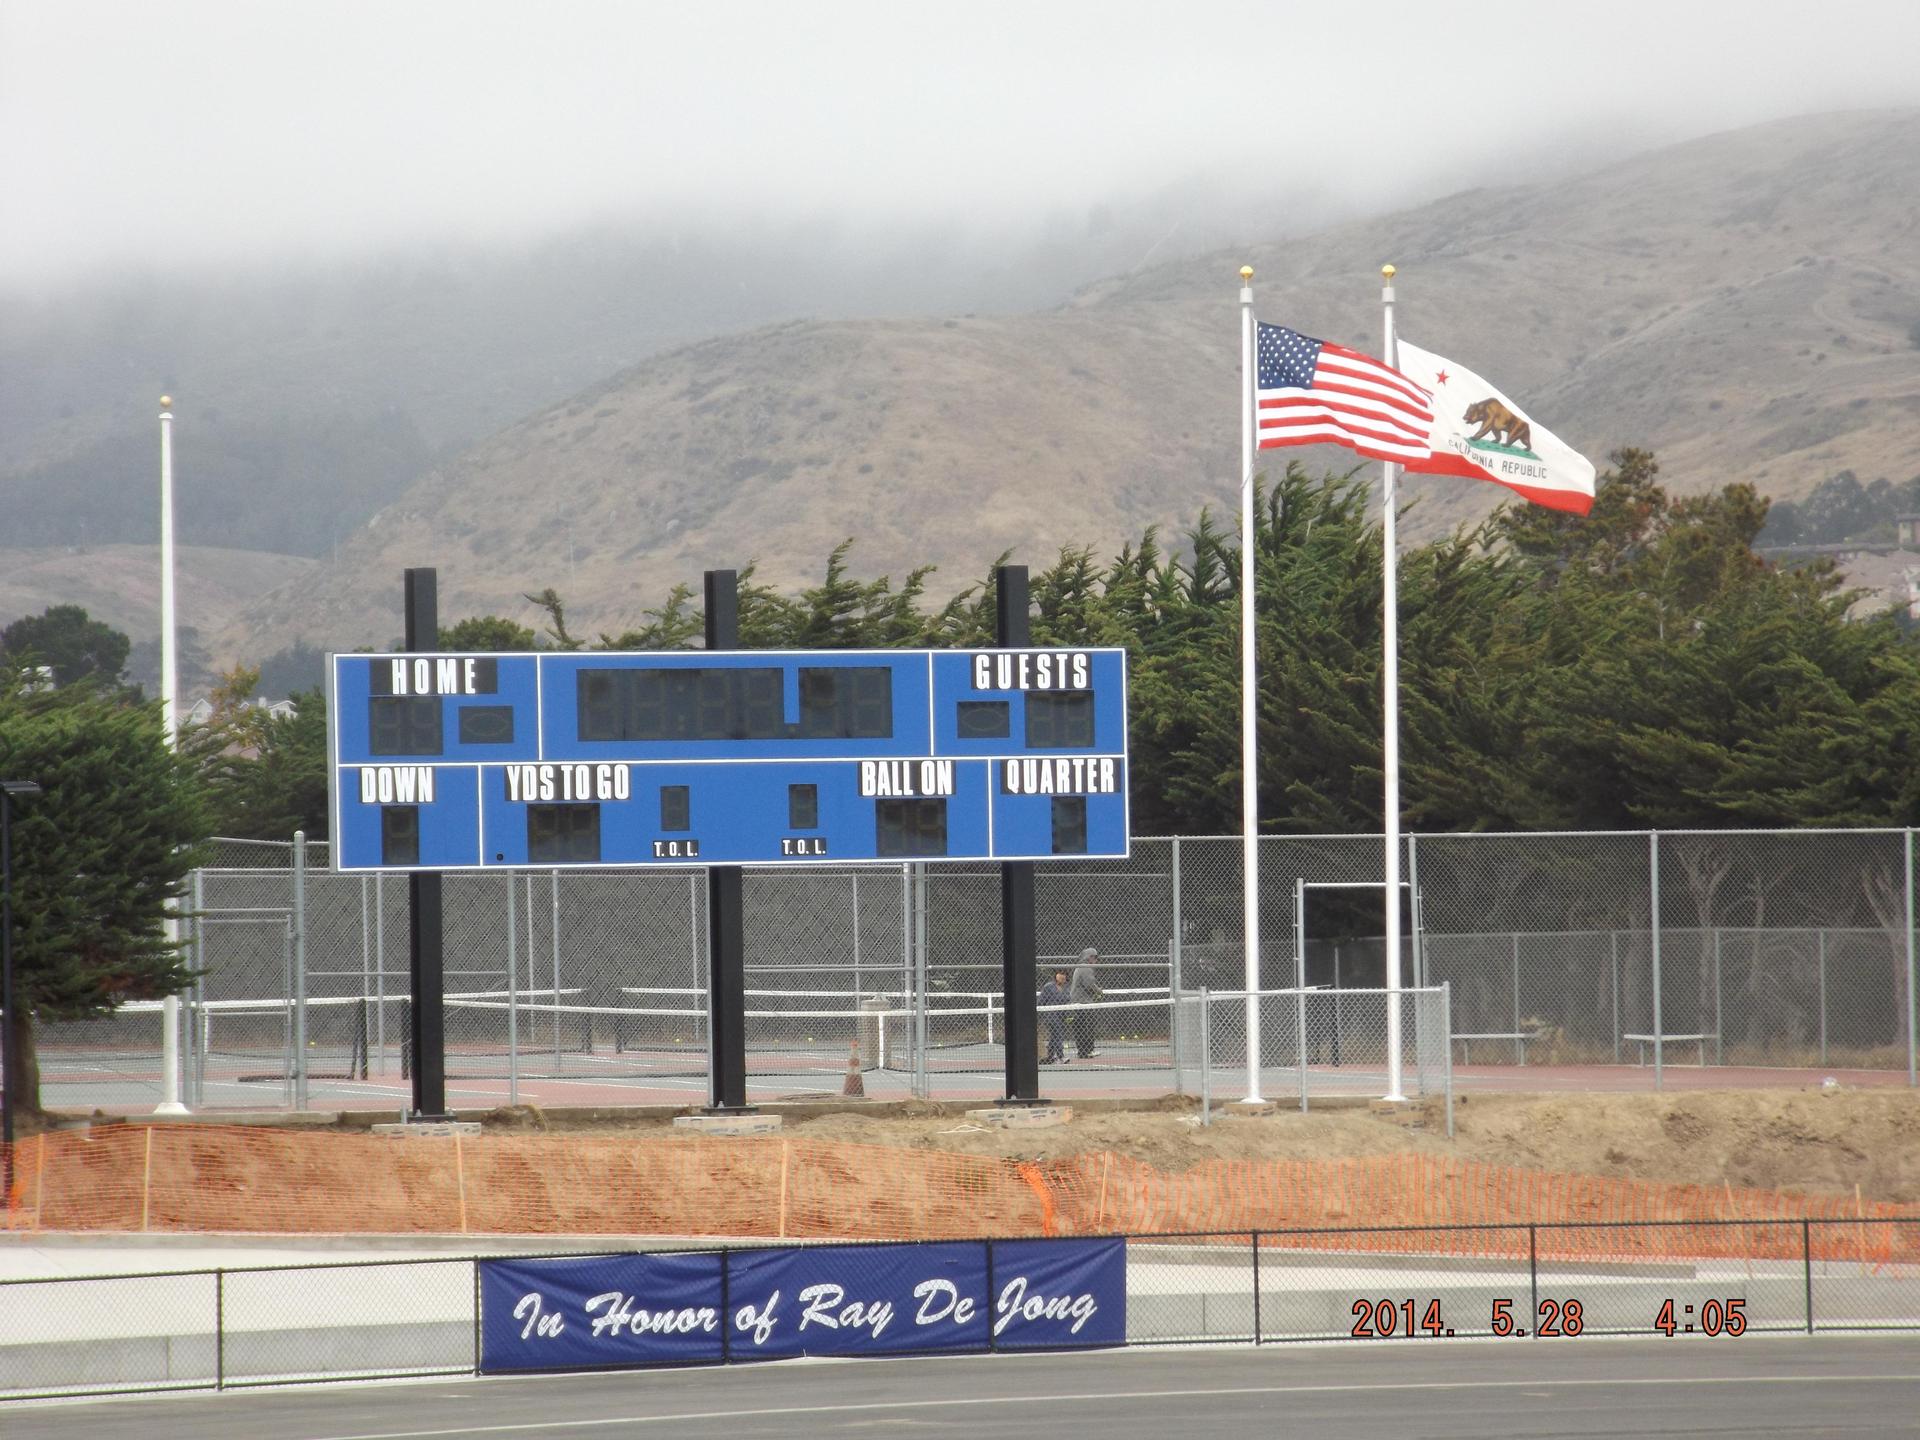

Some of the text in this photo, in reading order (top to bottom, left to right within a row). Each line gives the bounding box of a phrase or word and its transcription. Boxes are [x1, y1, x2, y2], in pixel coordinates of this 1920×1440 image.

[1501, 460, 1548, 479] REPUBLIC
[391, 658, 476, 695] HOME
[975, 653, 1087, 690] GUESTS
[361, 766, 433, 803] DOWN
[506, 764, 629, 801] YDS TO GO
[861, 759, 952, 796] BALL ON
[1006, 758, 1115, 794] QUARTER
[513, 1276, 1098, 1345] In Honor of Ray De Jong
